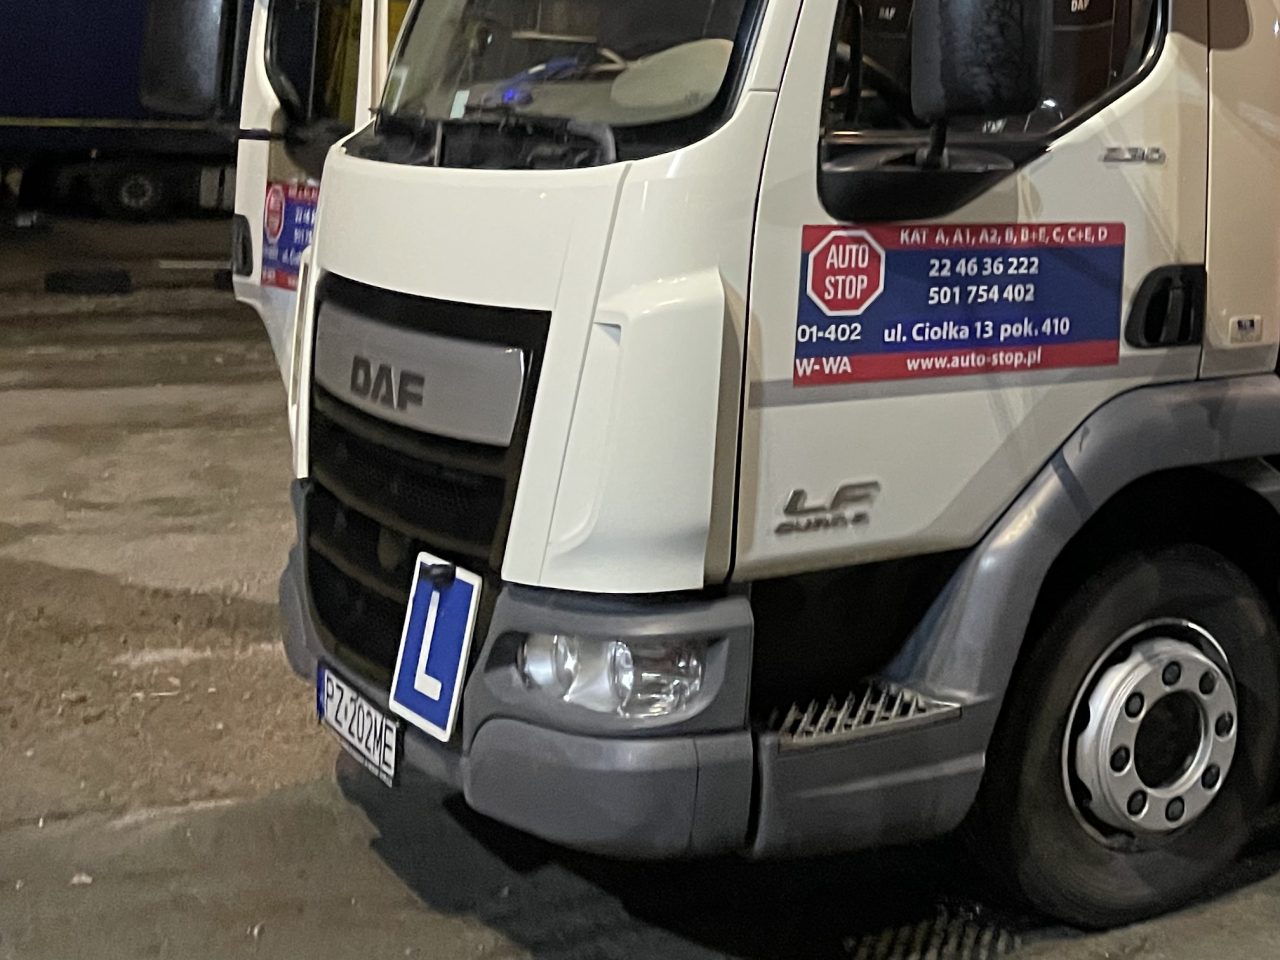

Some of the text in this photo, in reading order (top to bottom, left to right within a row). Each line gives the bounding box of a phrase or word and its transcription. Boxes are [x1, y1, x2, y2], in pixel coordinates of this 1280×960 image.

[1098, 226, 1108, 242] D
[826, 244, 869, 269] AUTO
[929, 256, 1039, 277] 22 46 36 222
[824, 275, 868, 301] STOP
[928, 283, 1035, 305] 501 754 402
[797, 323, 862, 343] 01-402
[884, 317, 1070, 342] ul. Ciołka 13 pok. 410
[906, 346, 1041, 371] www.auto-stop.pl
[351, 355, 425, 411] DAF
[784, 480, 881, 516] LF
[414, 590, 442, 700] L
